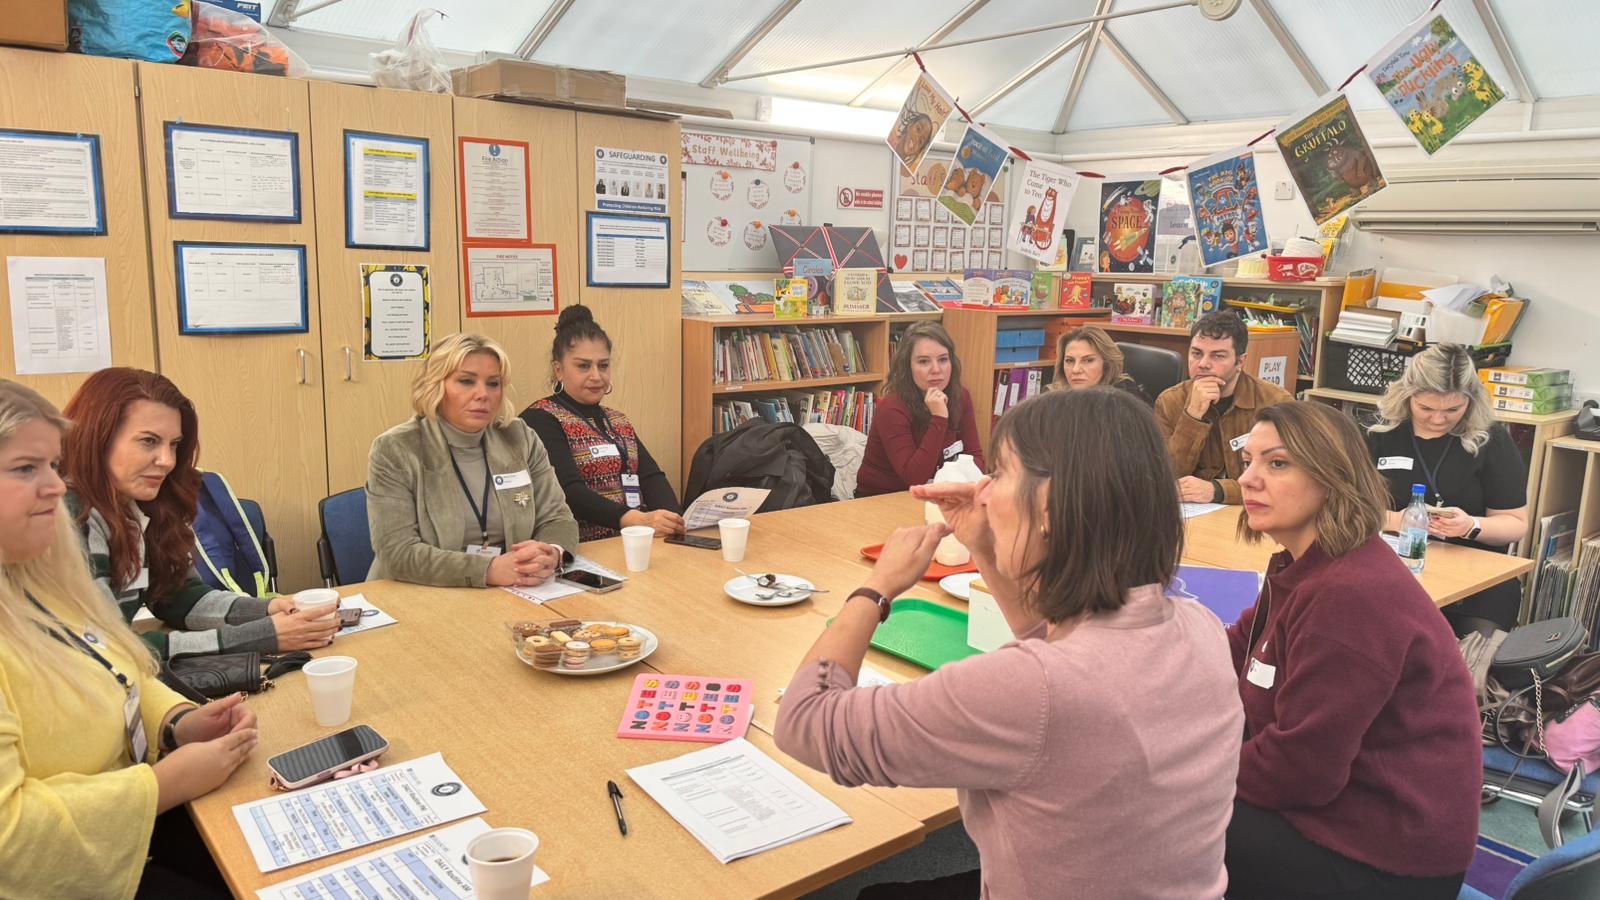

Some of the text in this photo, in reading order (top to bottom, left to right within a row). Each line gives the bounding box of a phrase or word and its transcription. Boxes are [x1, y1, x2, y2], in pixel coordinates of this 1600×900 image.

[1294, 120, 1346, 158] GRUFFALO
[481, 155, 509, 164] Fire Action
[608, 151, 656, 162] SAFEGUARDING
[691, 144, 760, 161] Staff Wellbeing
[1029, 170, 1072, 188] The Tiger Who
[1111, 215, 1143, 229] SPACE
[1264, 362, 1281, 372] PLAY
